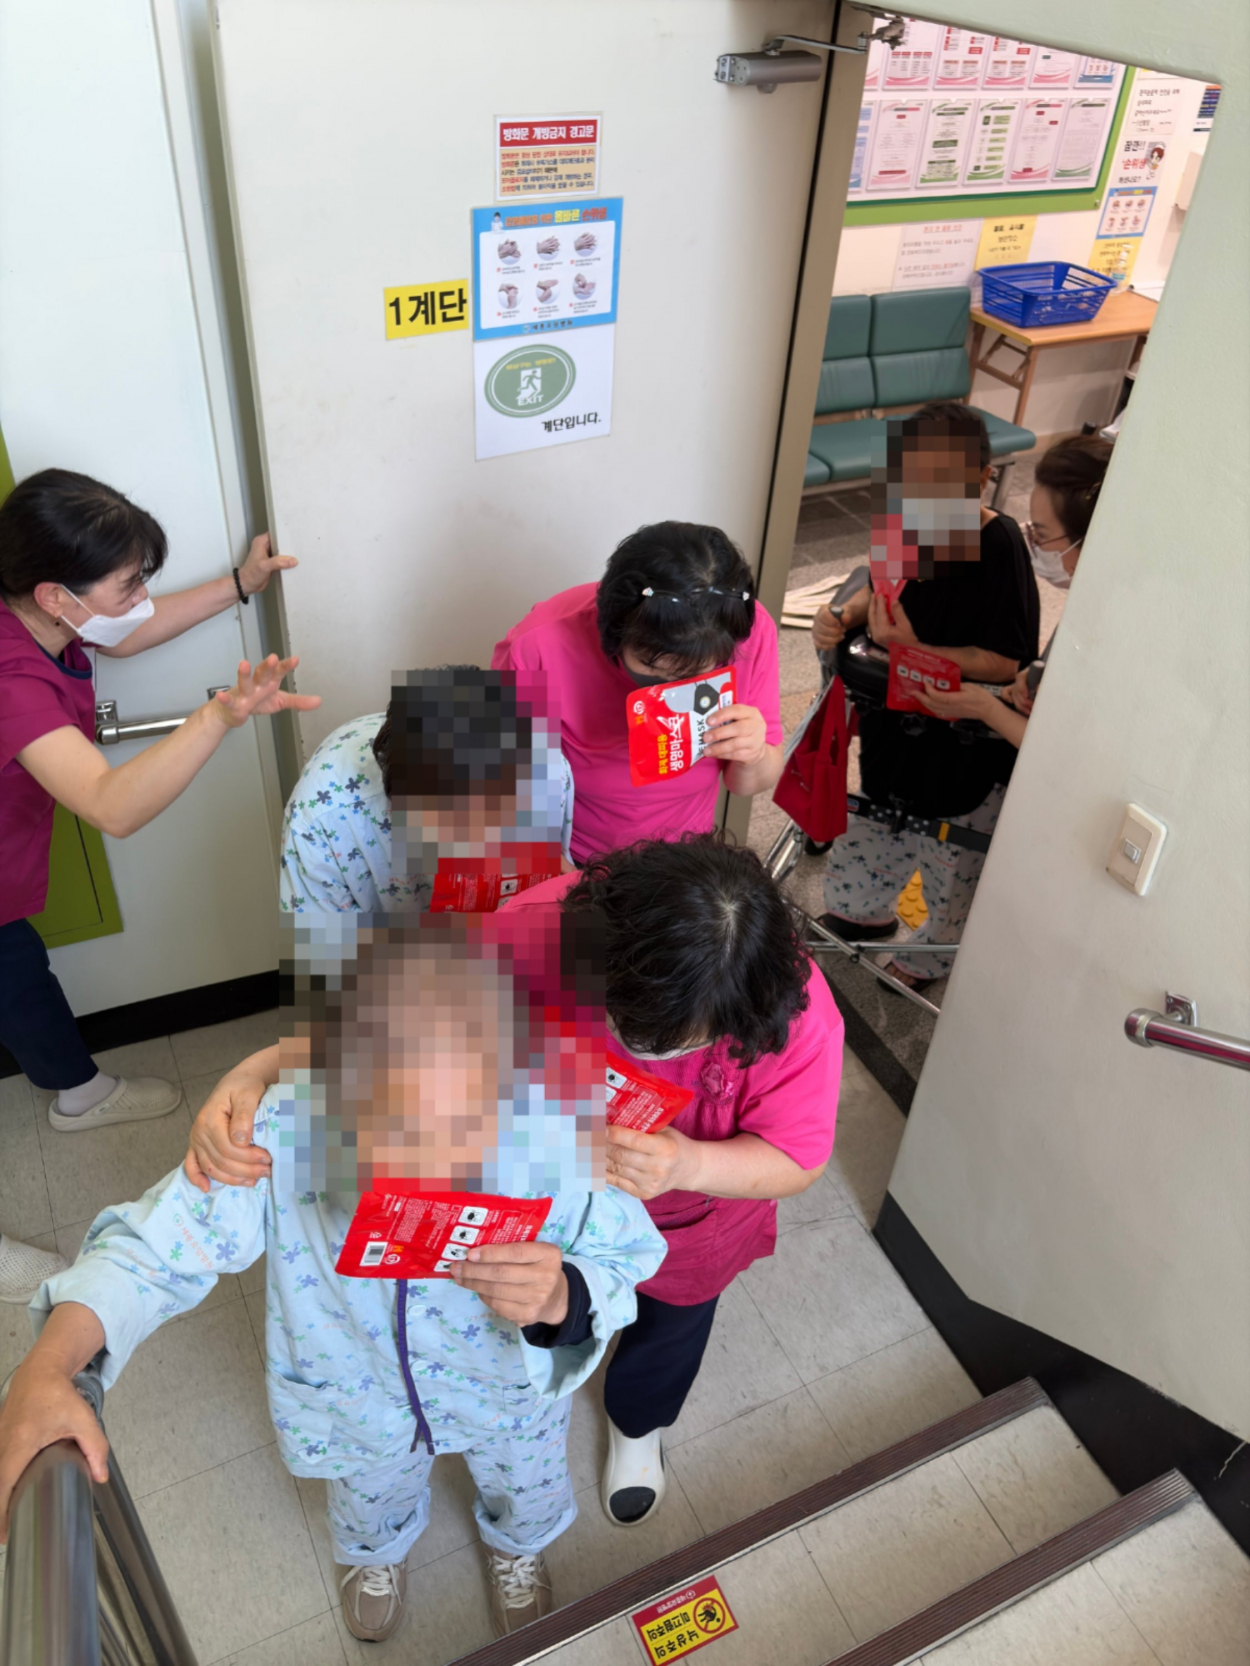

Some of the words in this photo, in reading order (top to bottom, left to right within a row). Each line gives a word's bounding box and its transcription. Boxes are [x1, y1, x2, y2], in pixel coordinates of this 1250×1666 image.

[503, 127, 529, 141] 방화문
[532, 126, 566, 140] 개방금지
[569, 125, 594, 138] 경고문
[554, 208, 580, 223] 올바른
[582, 207, 607, 221] 손위생
[389, 288, 468, 326] 1계단
[517, 394, 544, 406] EXIT
[541, 412, 602, 433] 계단입니다.
[657, 734, 668, 759] 대피용
[668, 714, 684, 771] 생명마스크
[646, 1611, 691, 1642] 미끄럼주의
[653, 1629, 700, 1660] 낙상주의
